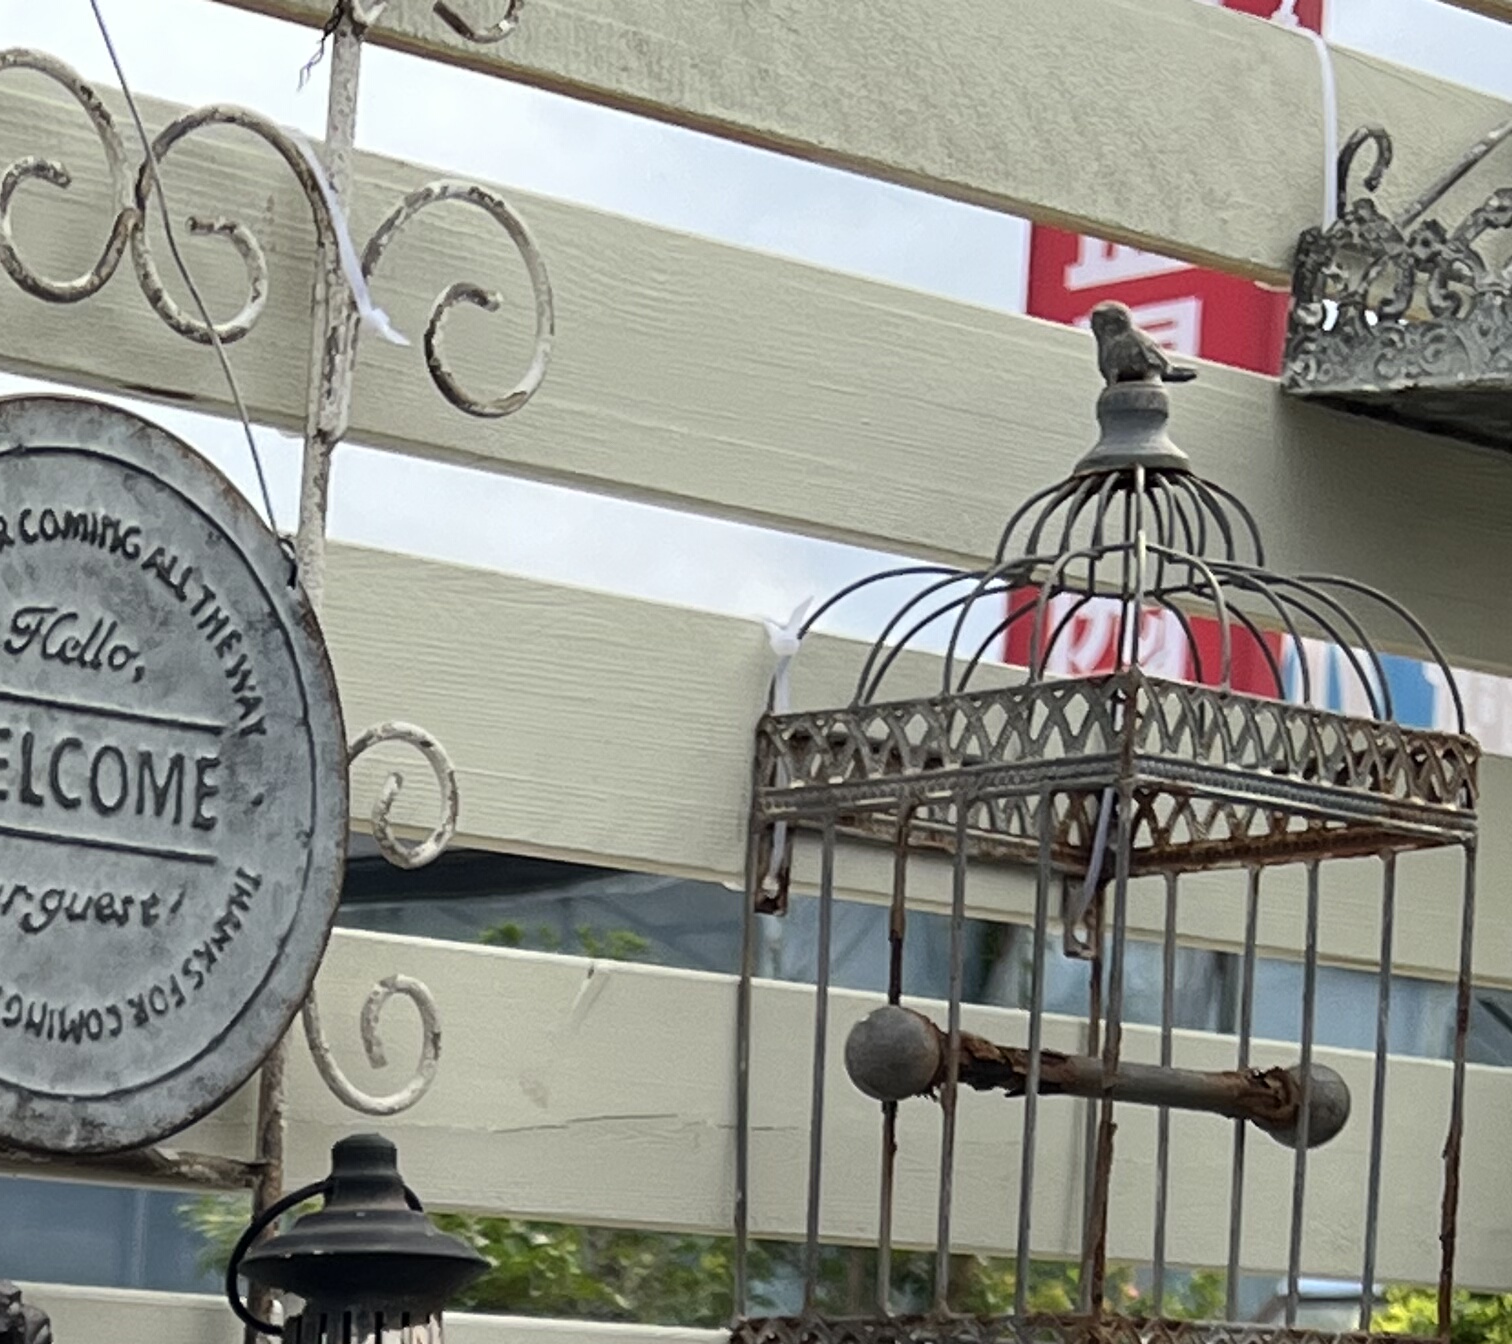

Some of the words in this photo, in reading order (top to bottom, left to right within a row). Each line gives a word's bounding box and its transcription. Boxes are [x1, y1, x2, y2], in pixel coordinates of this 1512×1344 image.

[3, 606, 146, 684] Hello,
[18, 507, 143, 560] COMING
[140, 546, 194, 602] ALL
[190, 584, 243, 659] THE
[224, 653, 268, 739] WAY
[181, 866, 263, 991] THANKS
[1, 993, 124, 1044] COMING
[127, 973, 186, 1027] FOR
